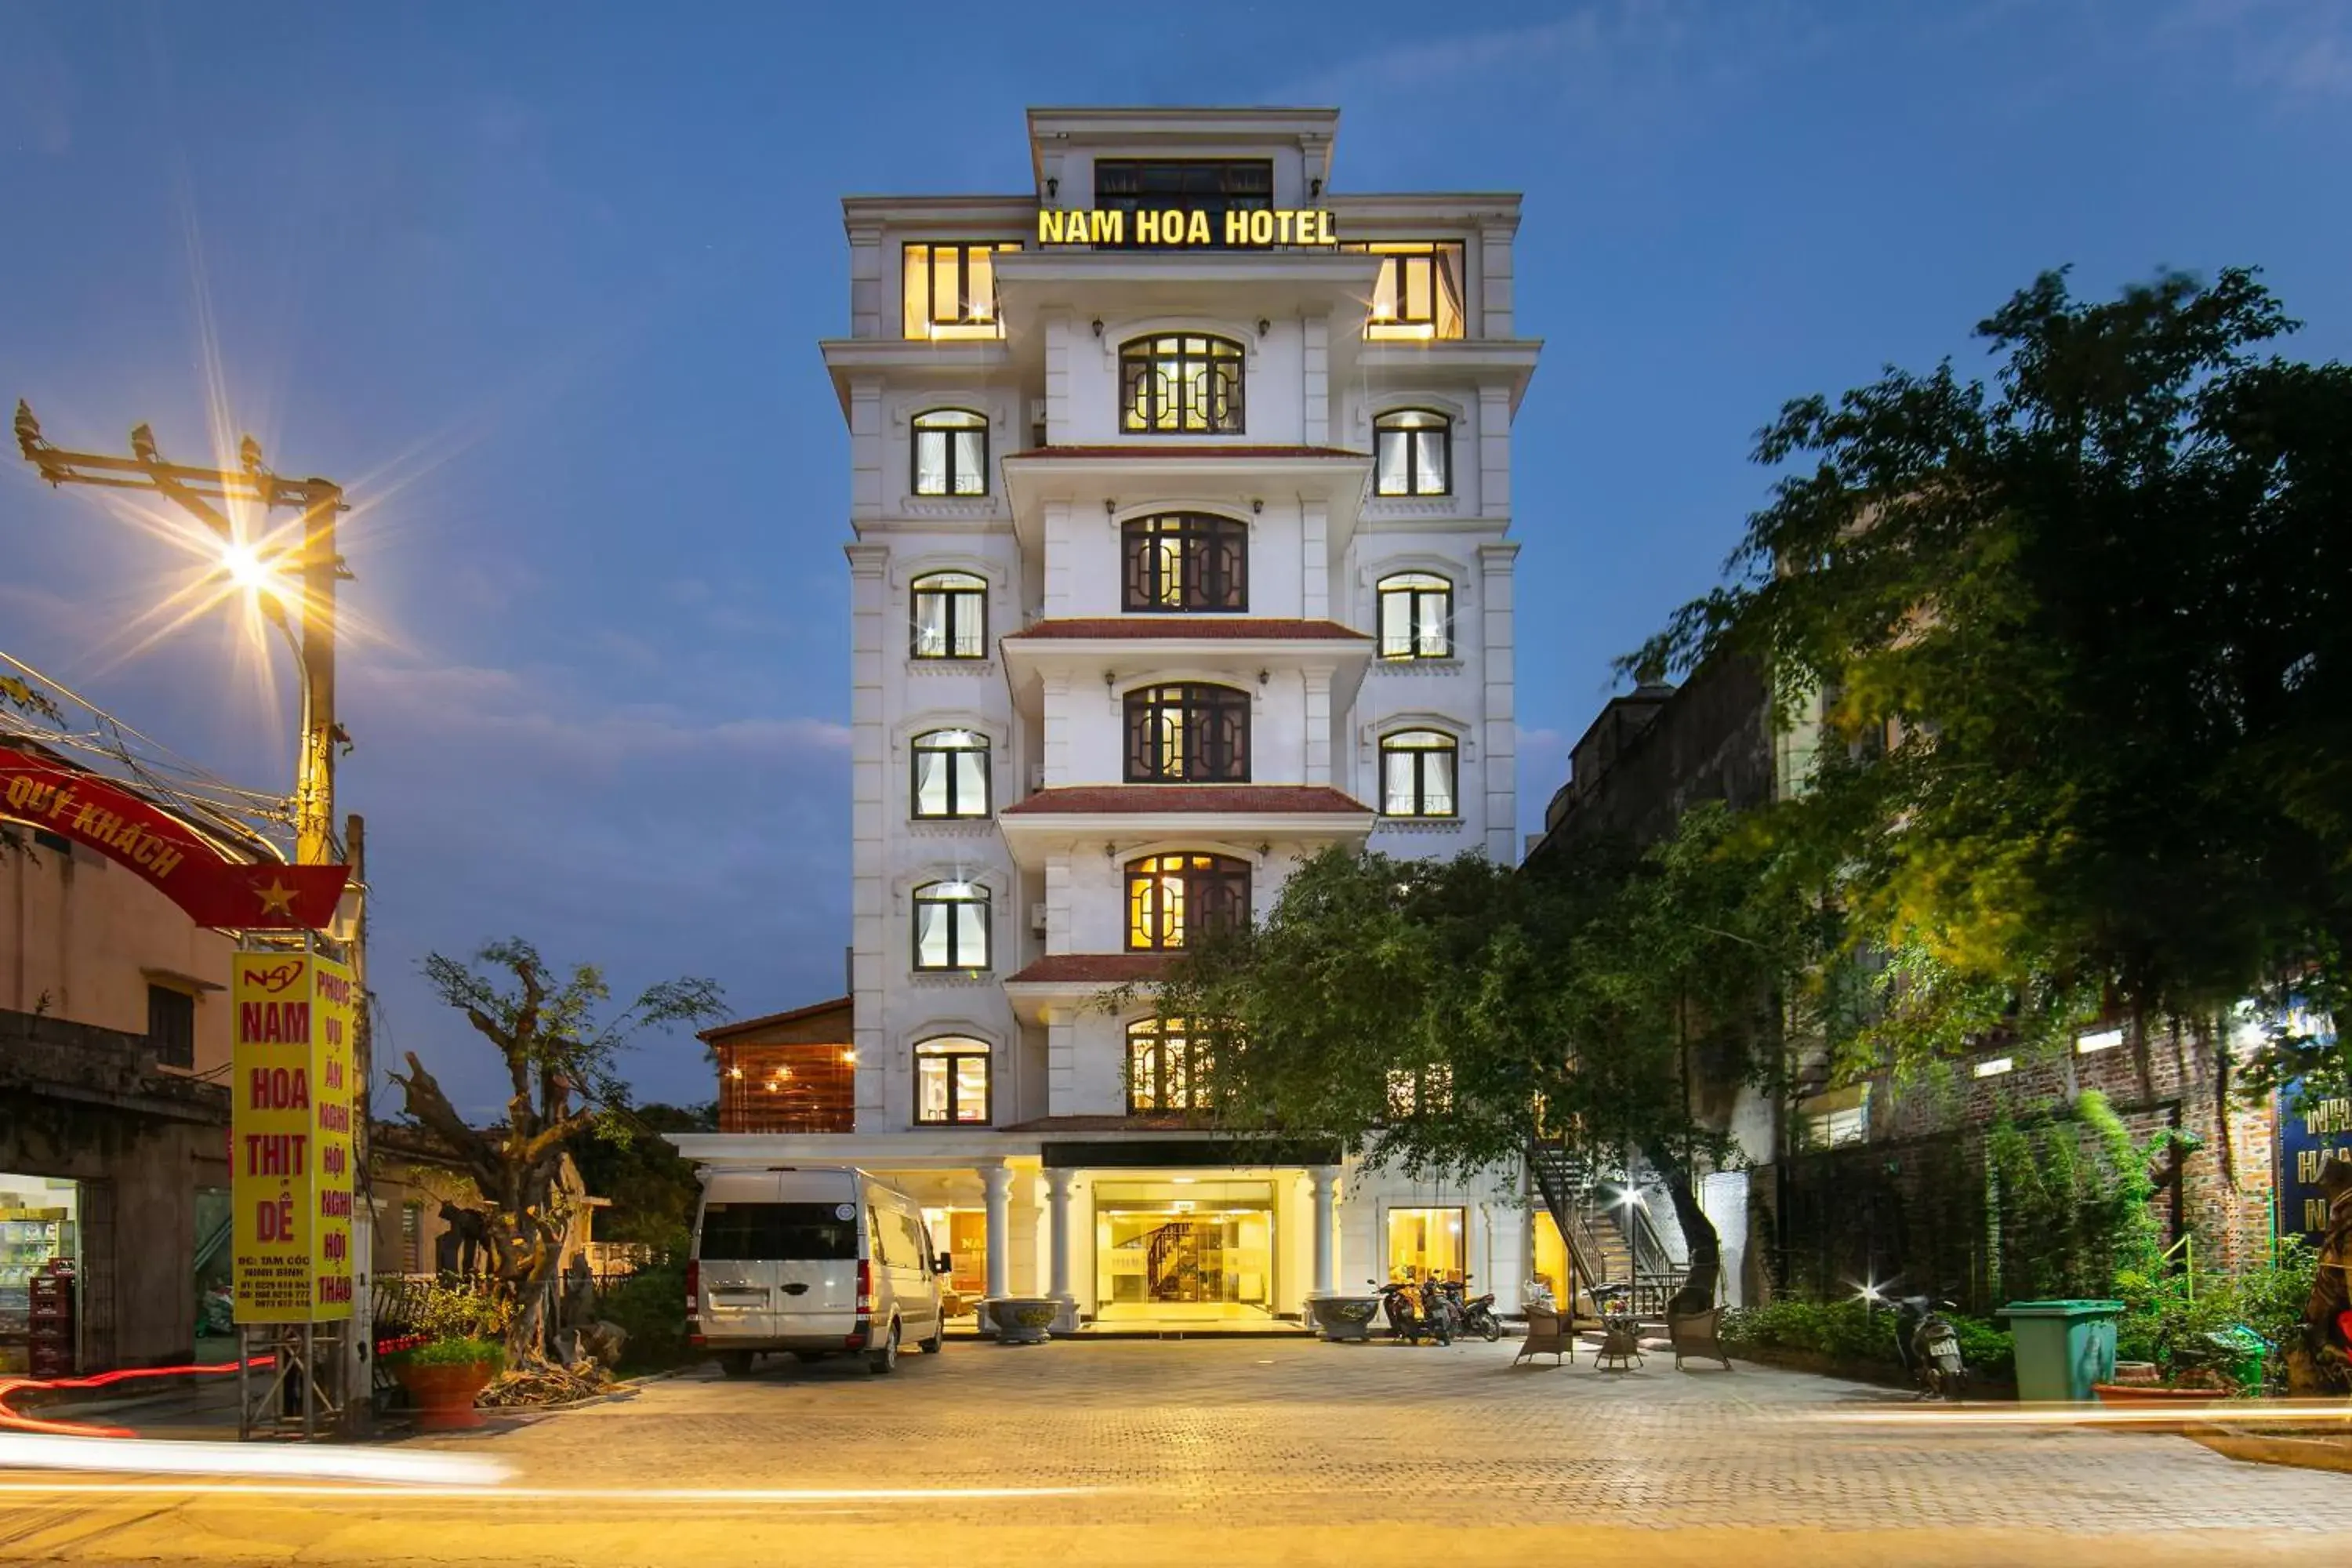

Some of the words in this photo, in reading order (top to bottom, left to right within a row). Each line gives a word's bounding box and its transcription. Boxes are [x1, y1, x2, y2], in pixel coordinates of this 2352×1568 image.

[1038, 209, 1123, 244] NAM
[1135, 209, 1211, 244] HOA
[1225, 209, 1337, 245] HOTEL
[6, 775, 78, 819] QUÝ
[71, 802, 184, 879] KHÁCH
[317, 970, 350, 1009] PHỤC
[240, 1001, 310, 1044] NAM
[325, 1016, 343, 1052] VỤ
[249, 1067, 310, 1110] HOA
[245, 1134, 307, 1187] THỊT
[322, 1142, 346, 1181] HỘI
[257, 1191, 294, 1243] DÊ
[321, 1189, 352, 1225] NGHỊ
[324, 1229, 347, 1265] HỘI
[318, 1268, 352, 1305] THẢO
